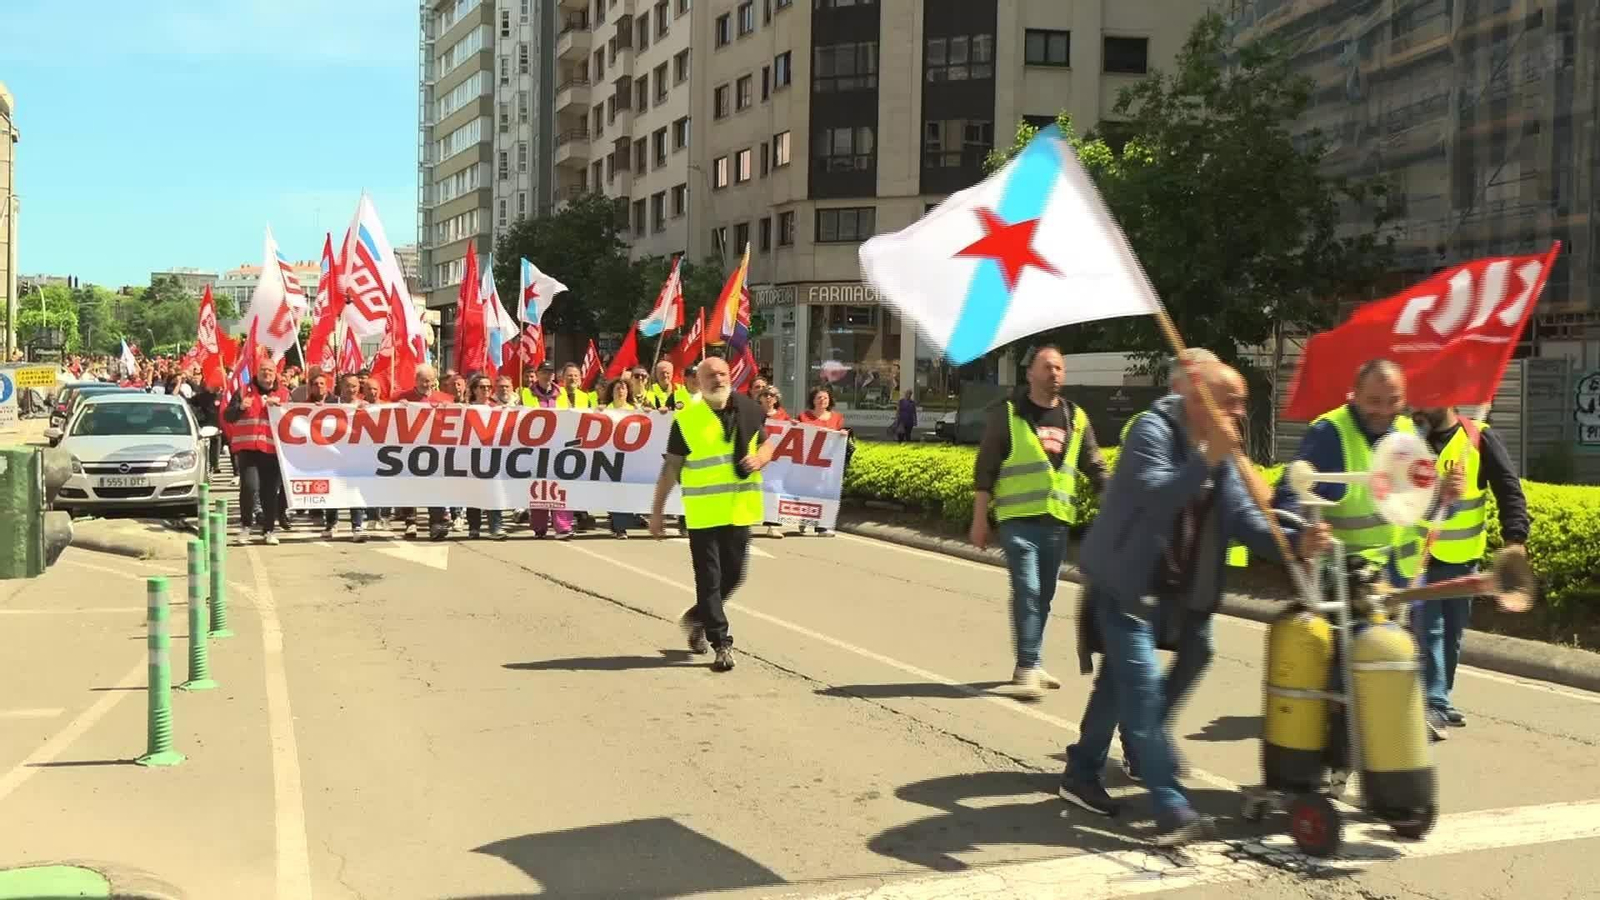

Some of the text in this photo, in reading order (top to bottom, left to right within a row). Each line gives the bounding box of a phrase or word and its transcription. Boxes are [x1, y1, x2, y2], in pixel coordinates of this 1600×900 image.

[808, 285, 880, 301] FARMACI
[278, 407, 832, 468] CONVENIO DO TAL
[376, 438, 625, 483] SOLUCIÓN
[290, 481, 313, 493] GT
[530, 480, 566, 501] CIG
